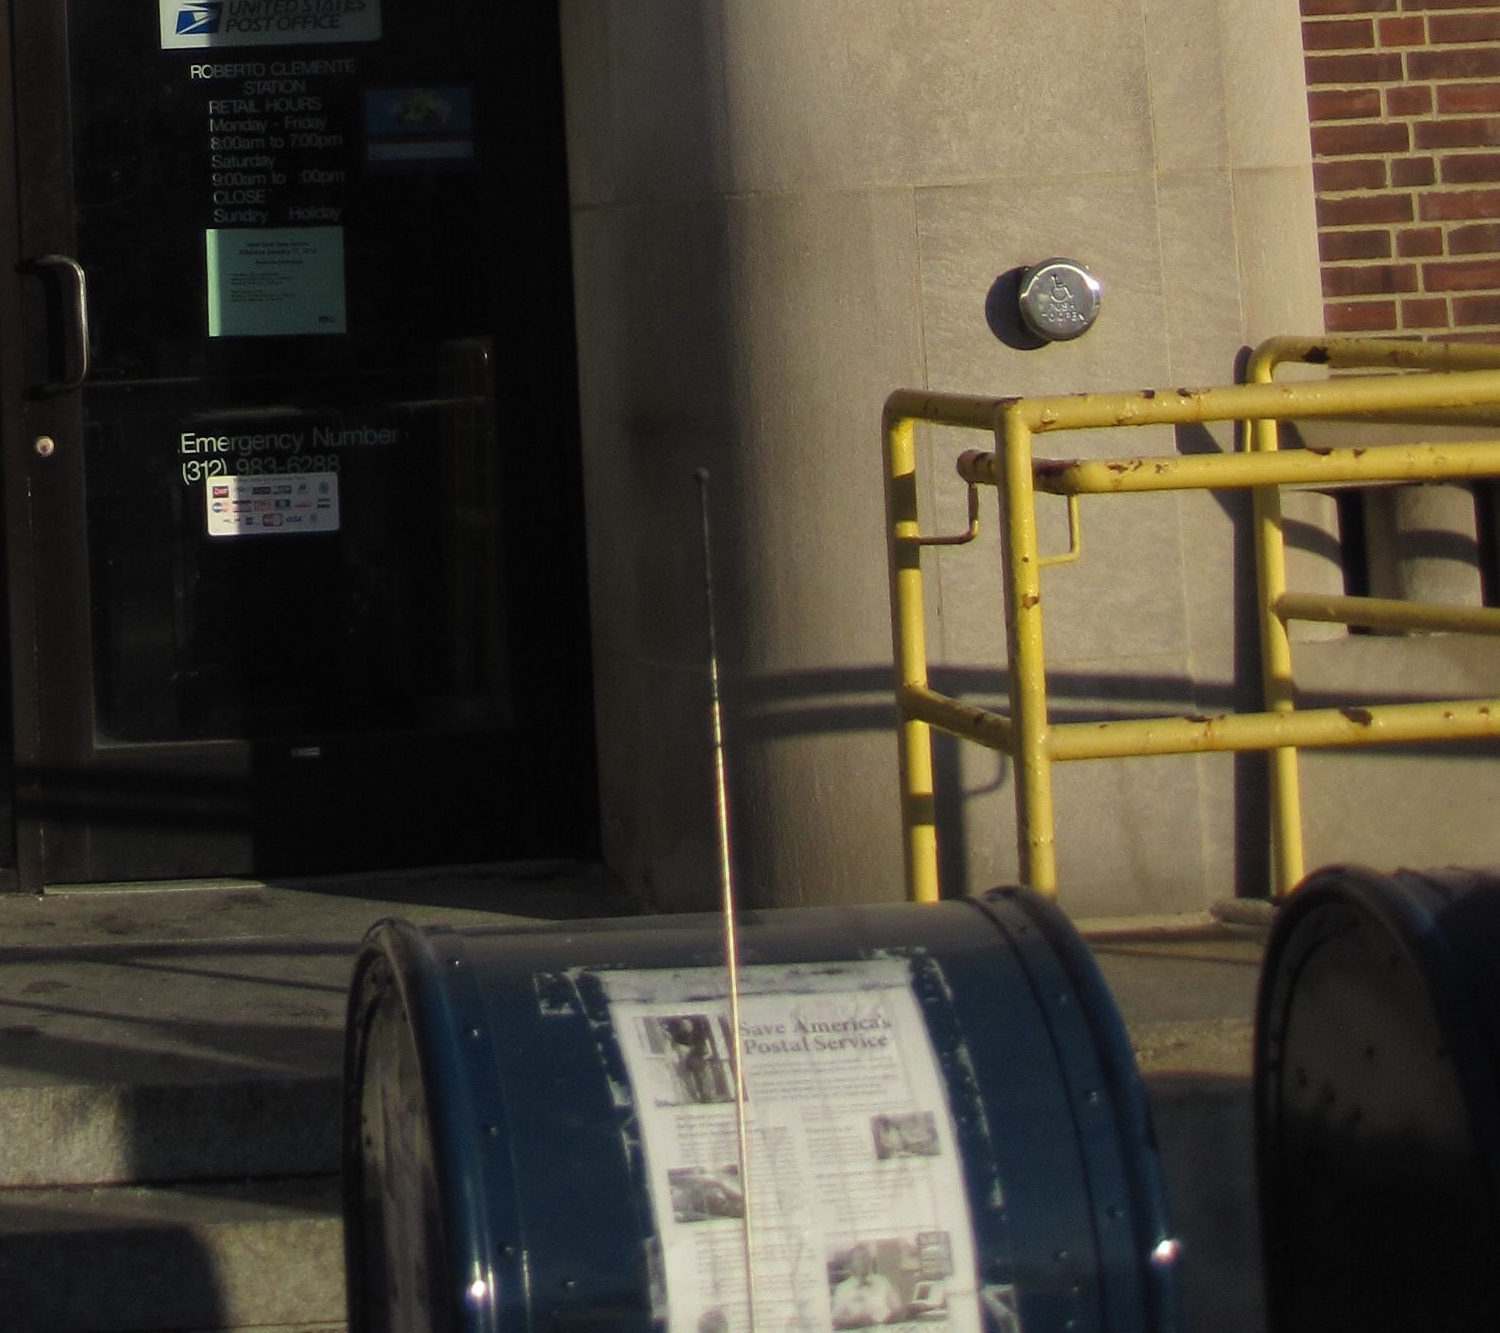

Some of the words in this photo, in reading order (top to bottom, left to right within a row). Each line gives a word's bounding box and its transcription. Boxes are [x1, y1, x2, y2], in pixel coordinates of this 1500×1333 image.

[226, 17, 275, 33] POST
[276, 15, 341, 31] OFFICE
[190, 62, 265, 79] ROBERTO
[269, 59, 356, 76] CLEMENTE
[243, 80, 306, 95] STATION
[209, 100, 261, 114] RETAIL
[265, 96, 322, 112] HOURS
[209, 118, 268, 133] Monday
[284, 116, 328, 131] Friday
[269, 135, 284, 149] to
[211, 154, 276, 170] Saturday
[271, 171, 286, 185] to
[213, 188, 274, 204] CLOSE
[289, 205, 342, 221] Holiday
[180, 431, 305, 456] Emergency
[312, 427, 399, 447] Number
[181, 457, 228, 485] (312)
[740, 1020, 786, 1037] Save
[793, 1012, 892, 1035] America's
[744, 1035, 812, 1055] Postal
[813, 1034, 888, 1052] Service
